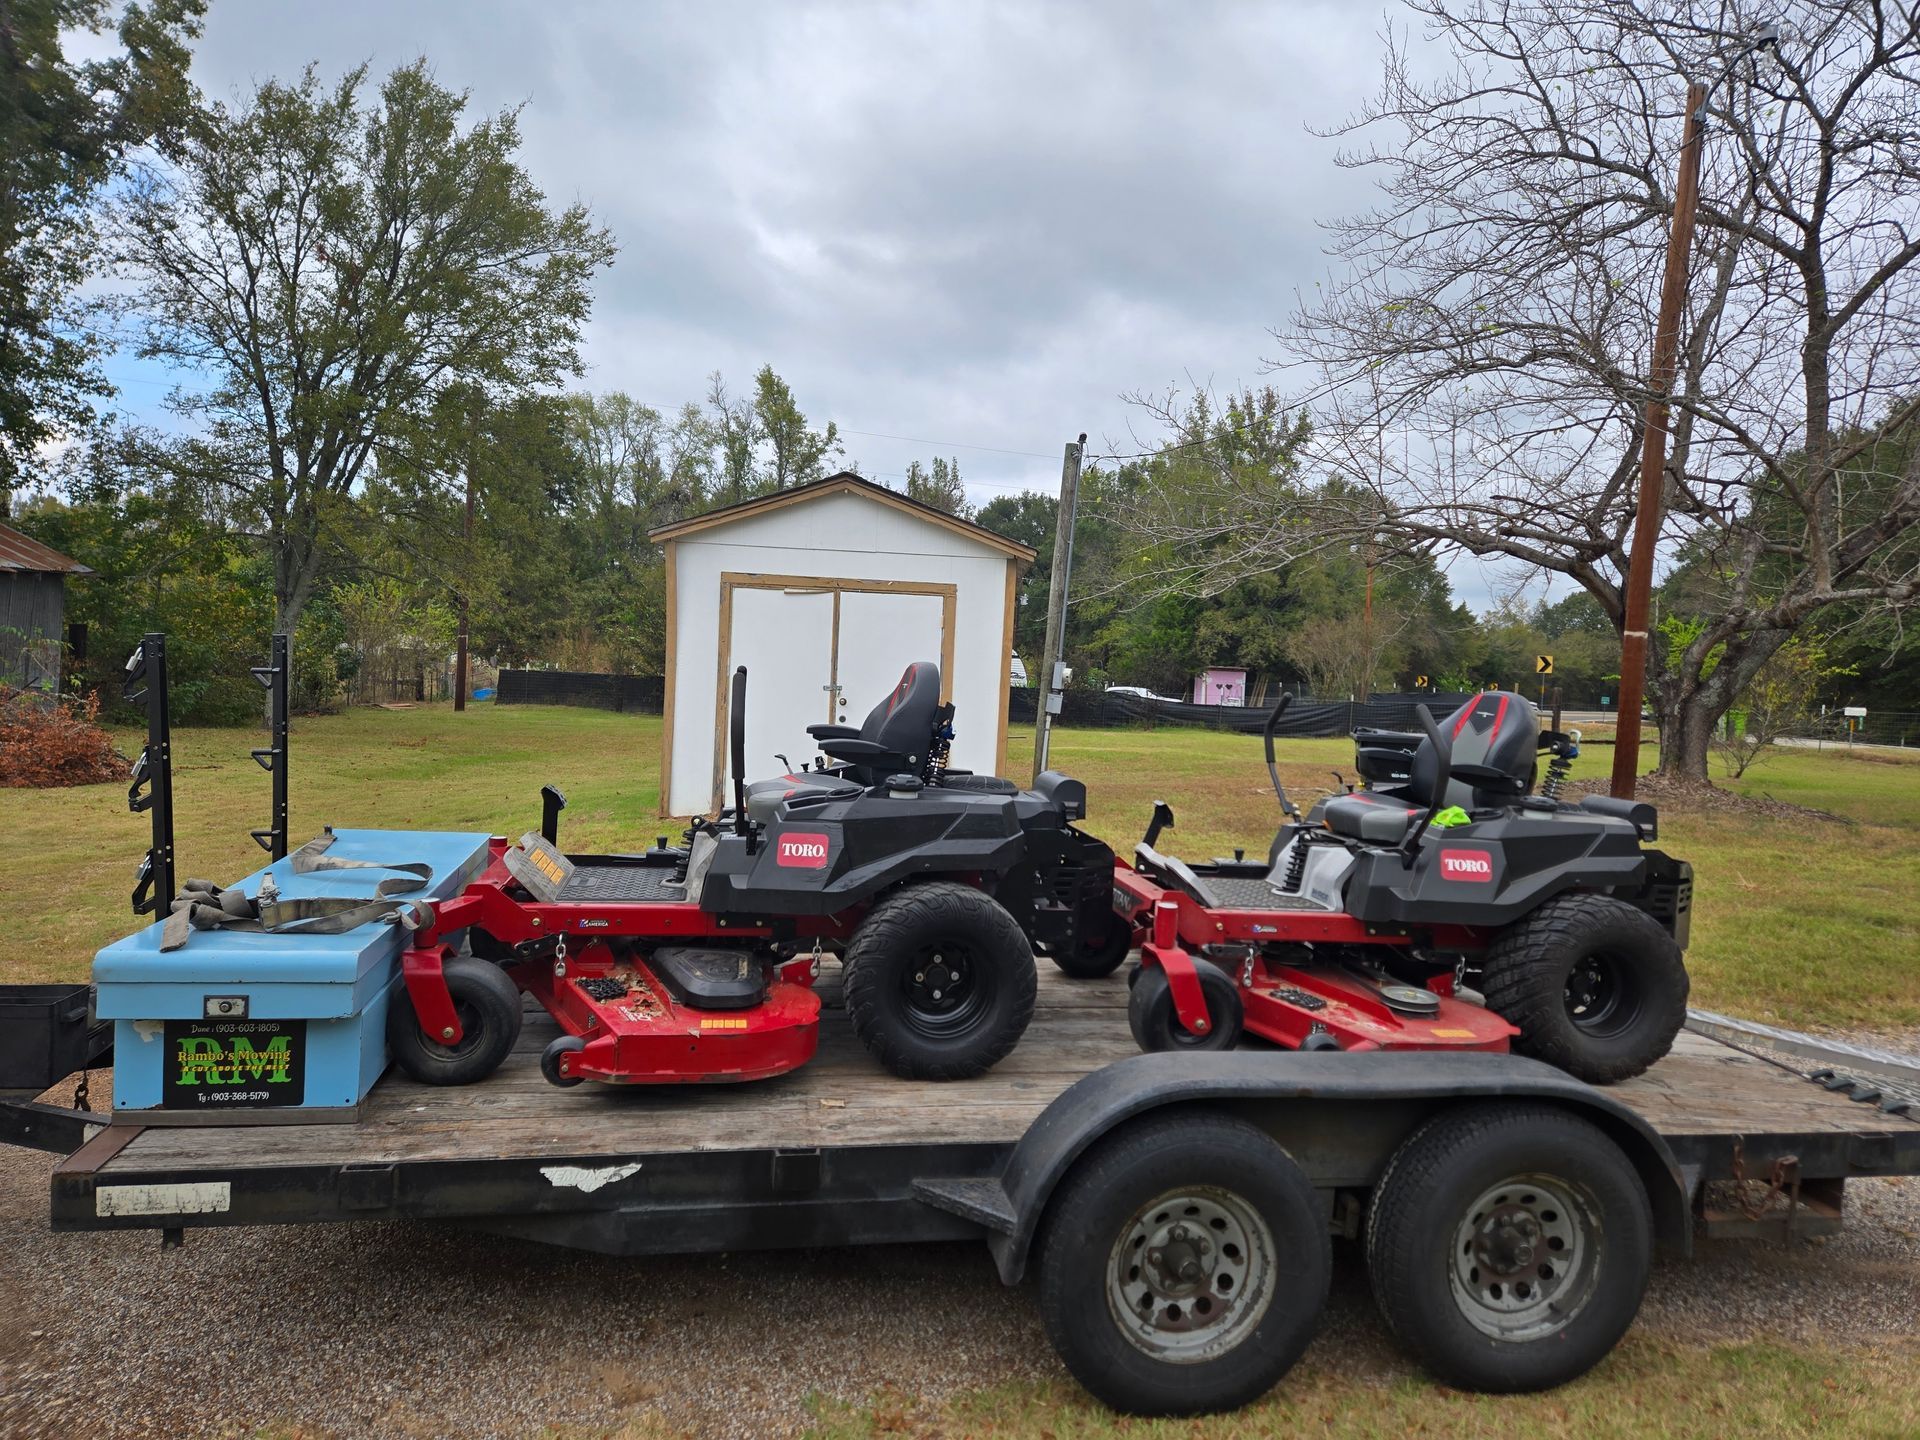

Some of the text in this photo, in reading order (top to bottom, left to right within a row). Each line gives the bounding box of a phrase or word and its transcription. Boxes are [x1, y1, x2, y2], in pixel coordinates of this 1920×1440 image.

[782, 843, 825, 857] TORO
[1445, 858, 1490, 873] TORO
[175, 1036, 293, 1085] RM
[177, 1049, 291, 1062] Rambo's Mowing
[211, 1091, 270, 1101] (903-368-5179)
